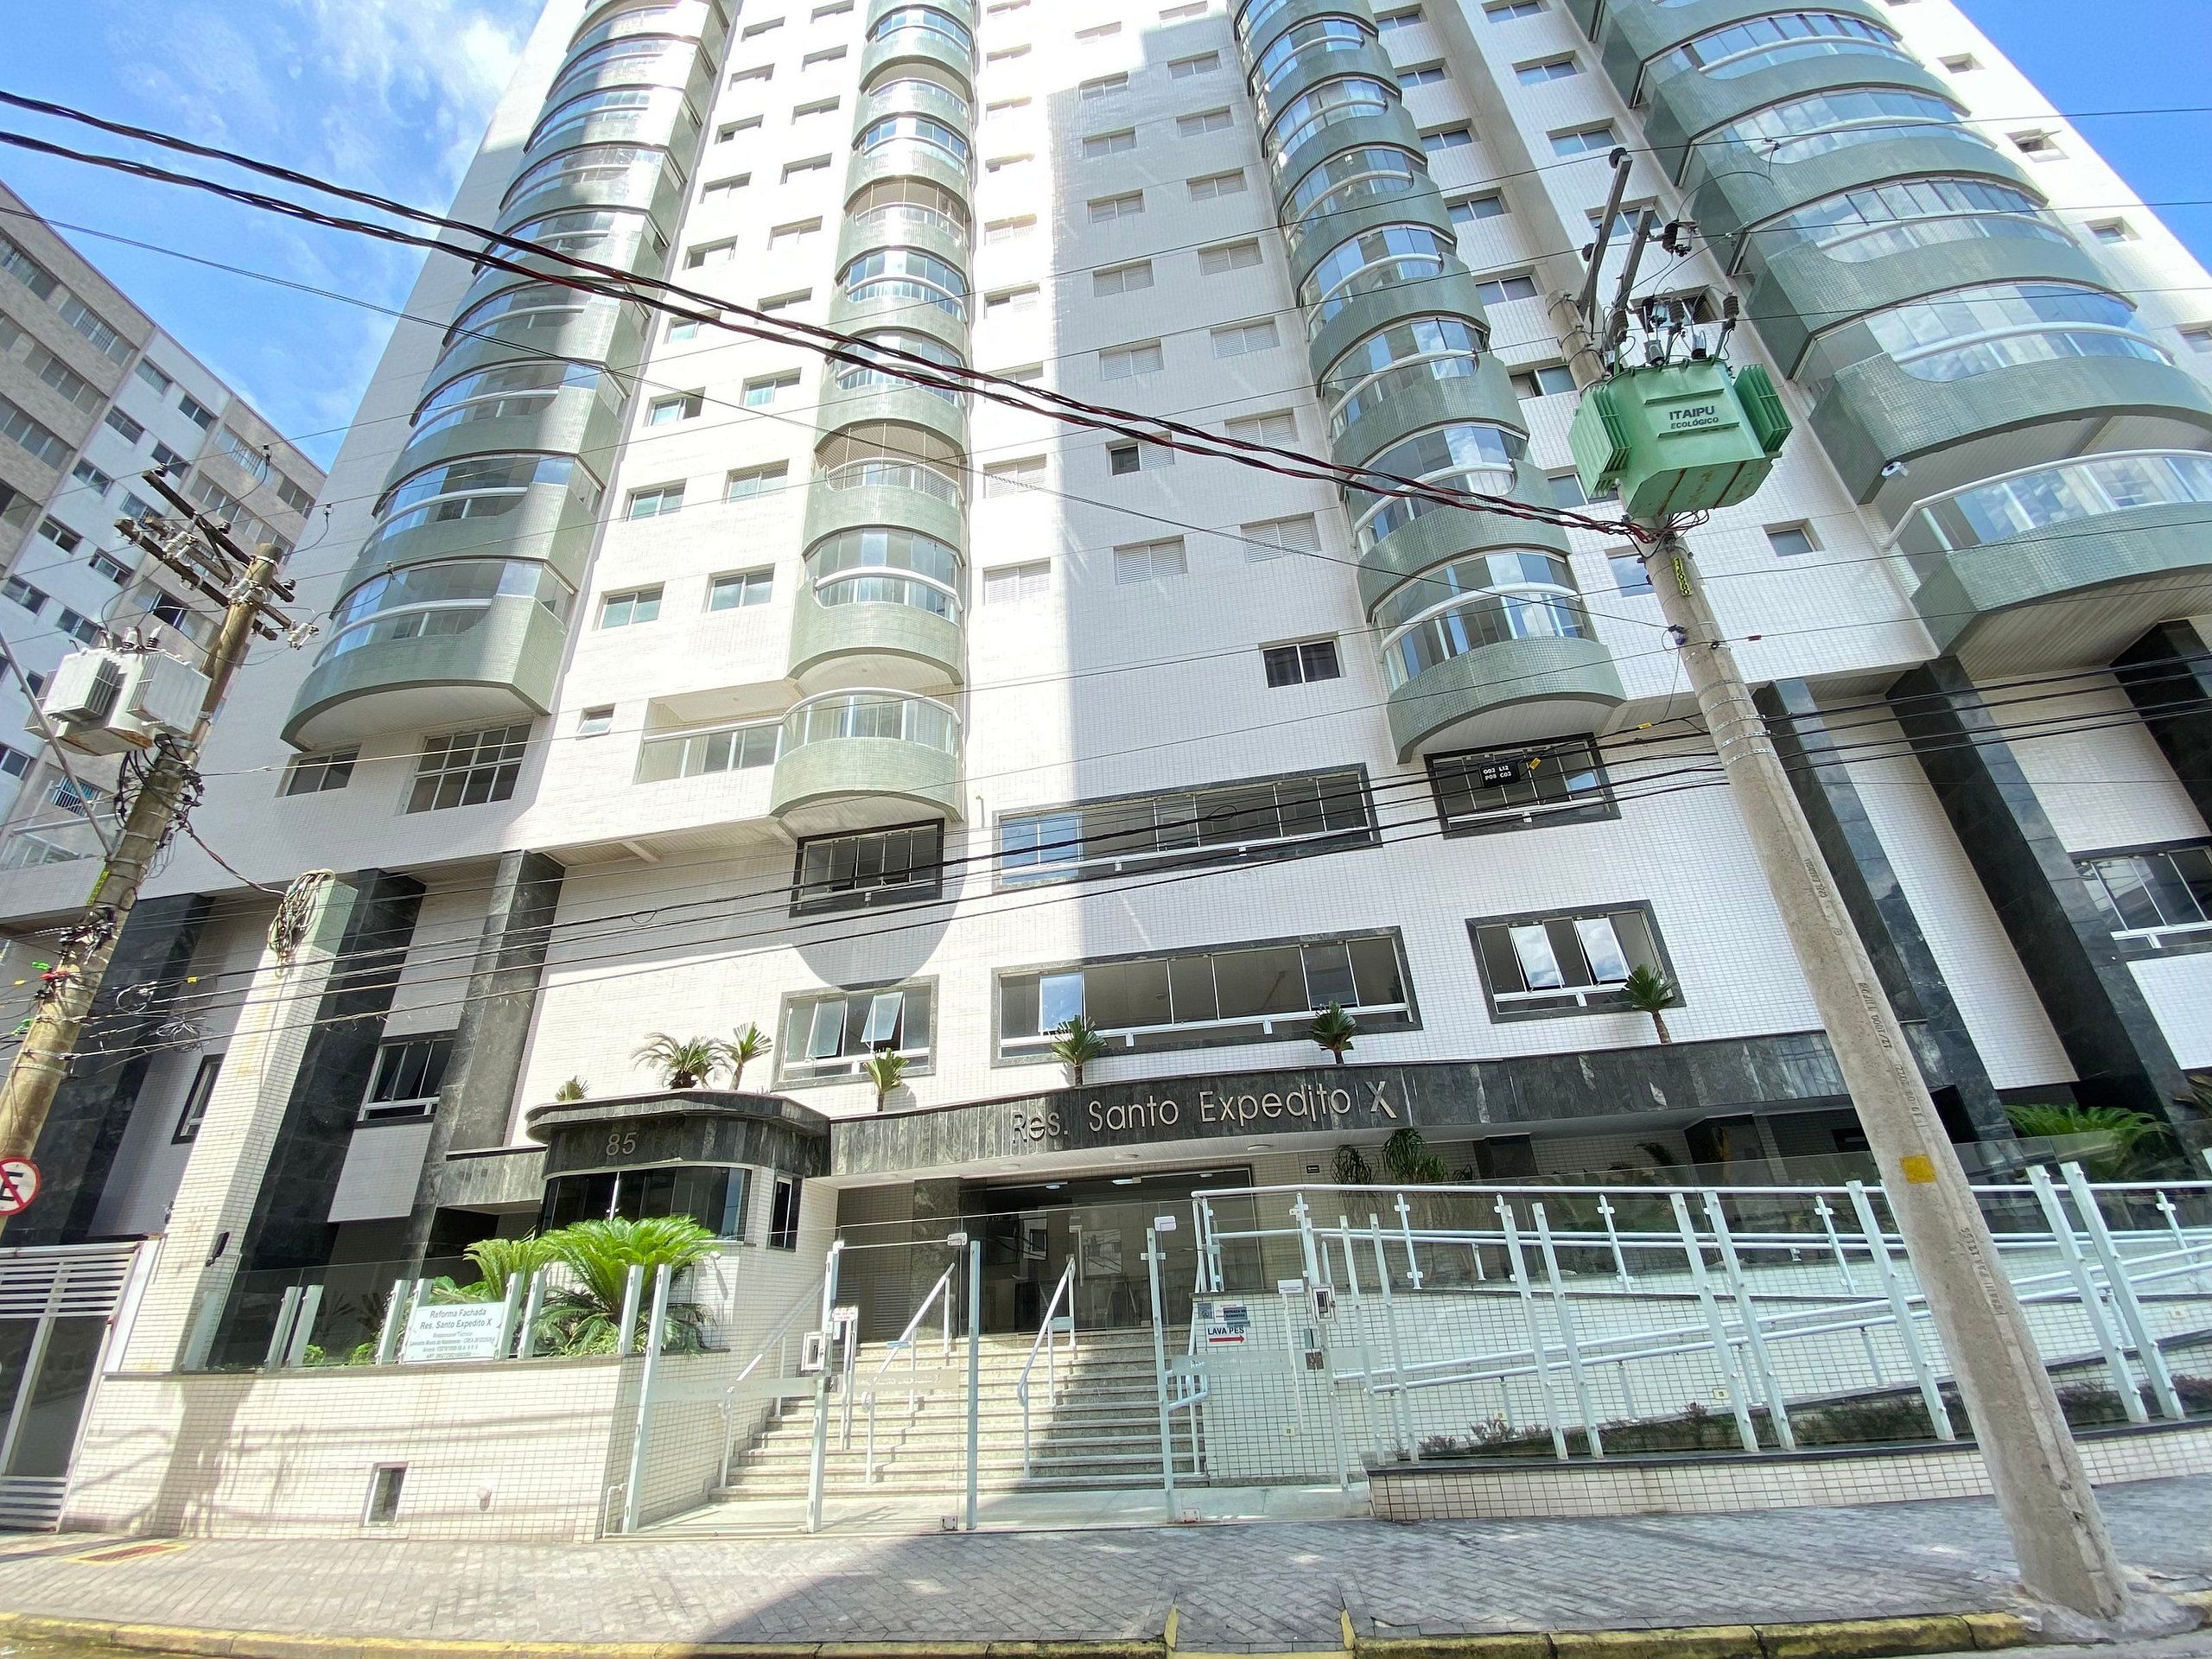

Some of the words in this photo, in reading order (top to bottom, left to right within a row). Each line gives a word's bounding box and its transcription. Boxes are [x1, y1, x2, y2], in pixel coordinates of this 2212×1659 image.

[1669, 405, 1715, 421] ITAIPU
[1669, 416, 1719, 429] ECOLÓGICO
[1011, 1109, 1069, 1144] Res.
[1088, 1094, 1179, 1132] Santo
[1198, 1084, 1351, 1127] Expedito
[1364, 1080, 1397, 1119] X
[605, 1131, 638, 1156] 85
[429, 1310, 457, 1319] Reforma
[458, 1307, 486, 1317] Fachada
[420, 1321, 434, 1330] Res.
[435, 1320, 455, 1329] Santo
[455, 1319, 485, 1330] Expedito
[486, 1318, 493, 1326] X
[1207, 1327, 1227, 1336] LAVA
